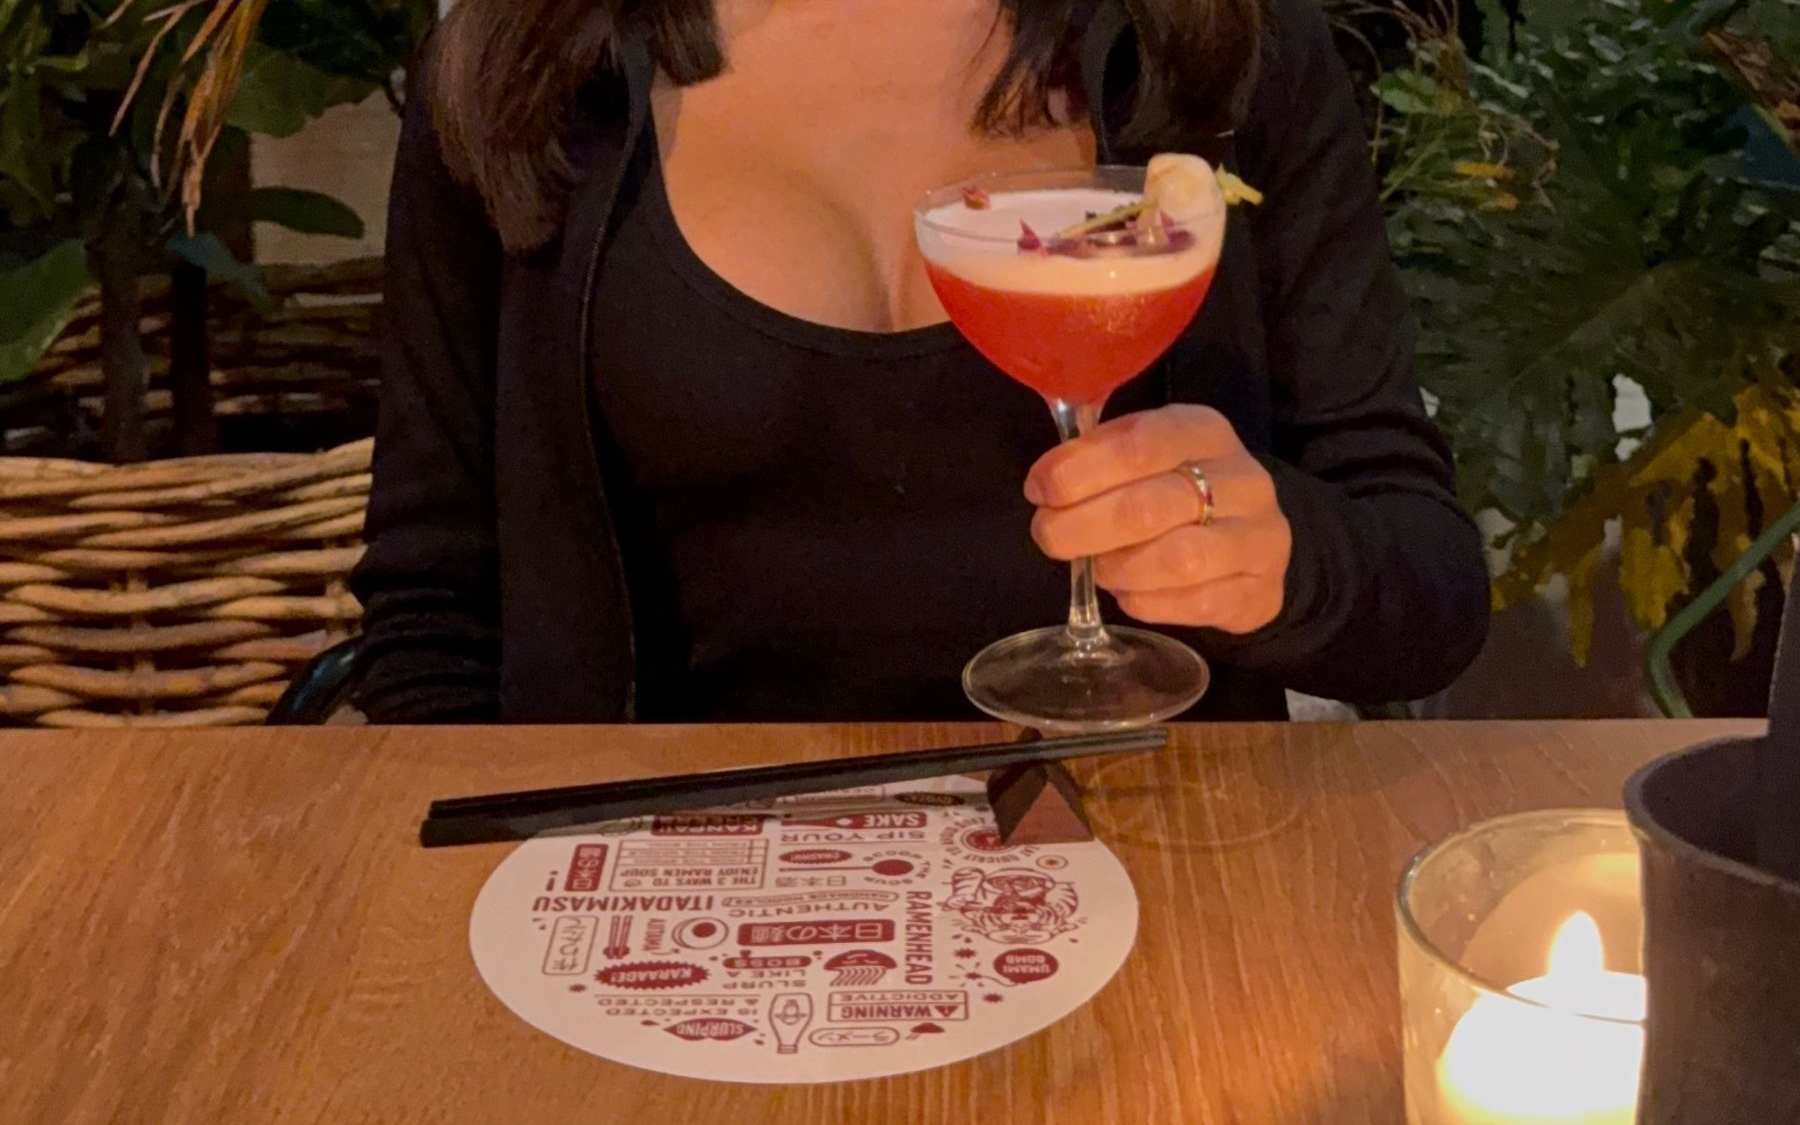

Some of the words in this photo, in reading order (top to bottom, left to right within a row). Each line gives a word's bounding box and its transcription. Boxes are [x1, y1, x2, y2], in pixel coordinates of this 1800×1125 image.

[864, 813, 920, 826] SAKE
[781, 832, 865, 842] YOUR
[877, 831, 926, 840] SIP
[620, 869, 658, 877] SOUP
[663, 868, 712, 876] RAMEN
[717, 867, 758, 876] ENJOY
[653, 878, 670, 887] TO
[676, 878, 712, 886] WAYS
[717, 877, 726, 885] 3
[733, 876, 756, 885] THE
[532, 895, 714, 911] ITADAKIMASU
[728, 903, 890, 917] AUTHENTIC
[905, 891, 932, 985] RAMENHEAD
[734, 959, 800, 967] BOSS
[1006, 955, 1046, 964] BOMB
[1003, 964, 1050, 973] UMAMI
[610, 968, 691, 983] KARAAGE!
[722, 979, 806, 989] SLURP
[840, 993, 958, 1001] ADDICTIVE
[606, 1008, 728, 1016] EXPECTED
[840, 1005, 932, 1018] WARNING
[676, 1023, 744, 1036] SLURPING
